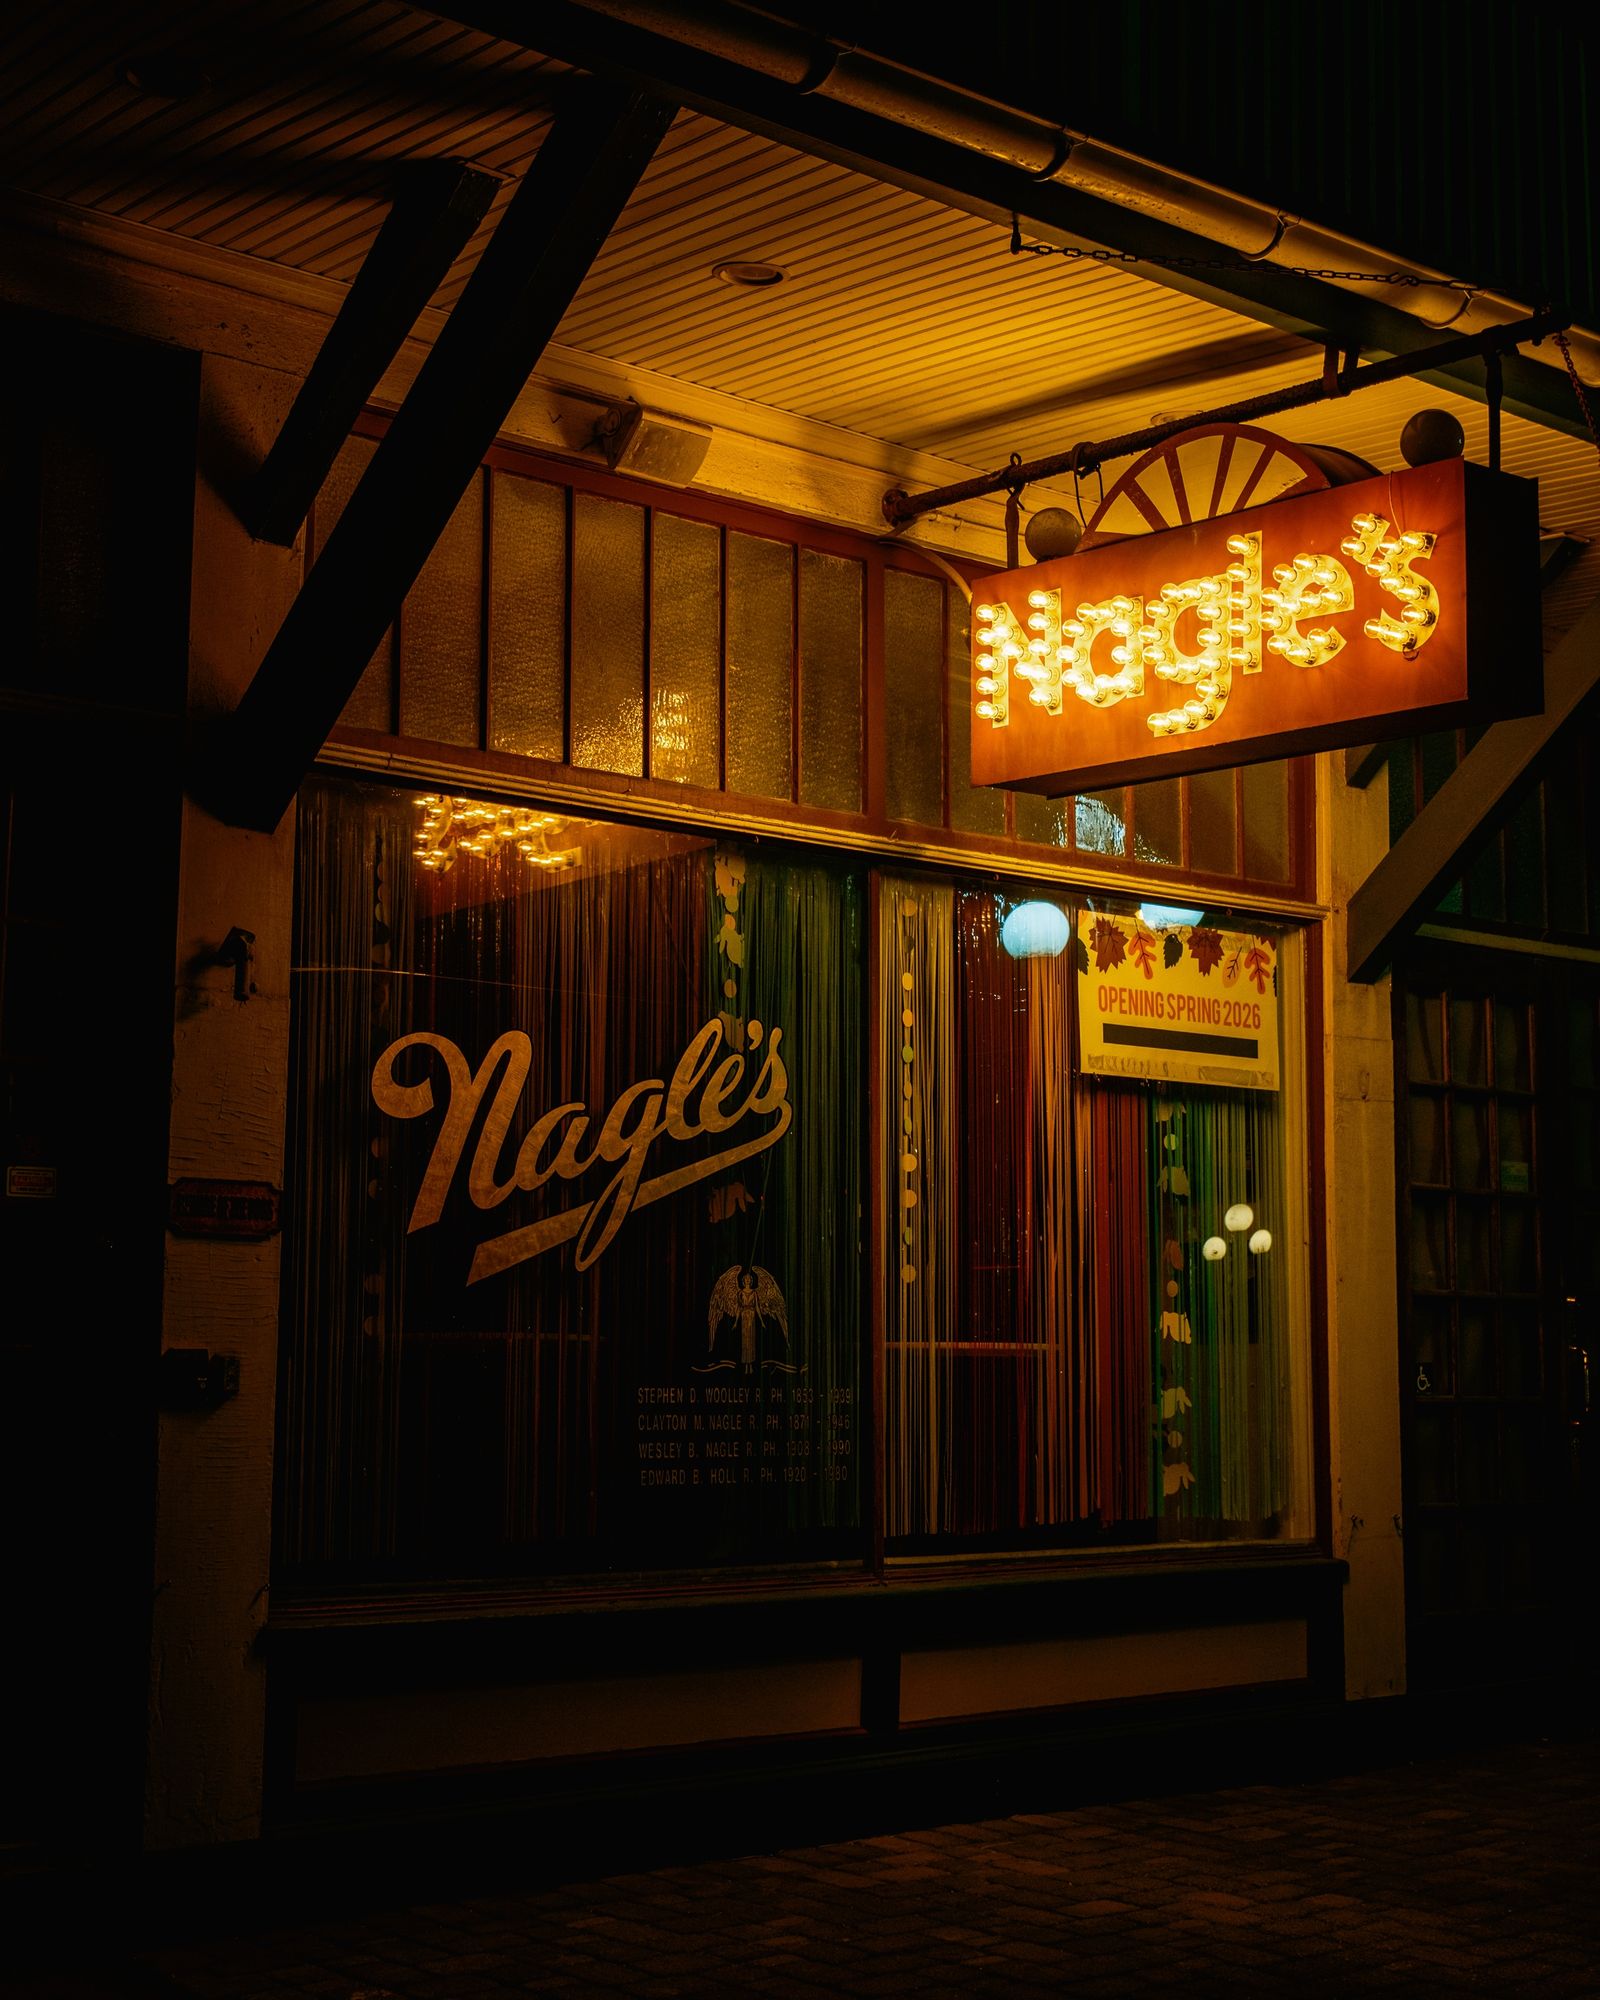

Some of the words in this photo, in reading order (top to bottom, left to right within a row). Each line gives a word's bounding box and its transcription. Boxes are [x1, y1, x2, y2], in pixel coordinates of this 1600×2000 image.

[975, 512, 1440, 738] Nagle's
[1097, 985, 1164, 1020] OPENING
[1167, 993, 1221, 1025] SPRING
[1223, 1000, 1261, 1030] 2026
[370, 1016, 793, 1287] Nagle's
[637, 1387, 684, 1404] STEPHEN
[705, 1387, 751, 1404] WOOLLEY
[772, 1387, 785, 1403] PH.
[638, 1414, 688, 1431] CLAYTON
[694, 1414, 704, 1431] M.
[709, 1414, 743, 1431] NAGLE
[767, 1414, 784, 1430] PH.
[638, 1441, 682, 1459] WESLEY
[688, 1441, 700, 1458] B.
[705, 1441, 741, 1458] NAGLE
[763, 1441, 779, 1457] PH.
[640, 1469, 686, 1486] EDWARD
[692, 1468, 703, 1485] B.
[710, 1468, 737, 1485] HOLL
[760, 1466, 777, 1483] PH.
